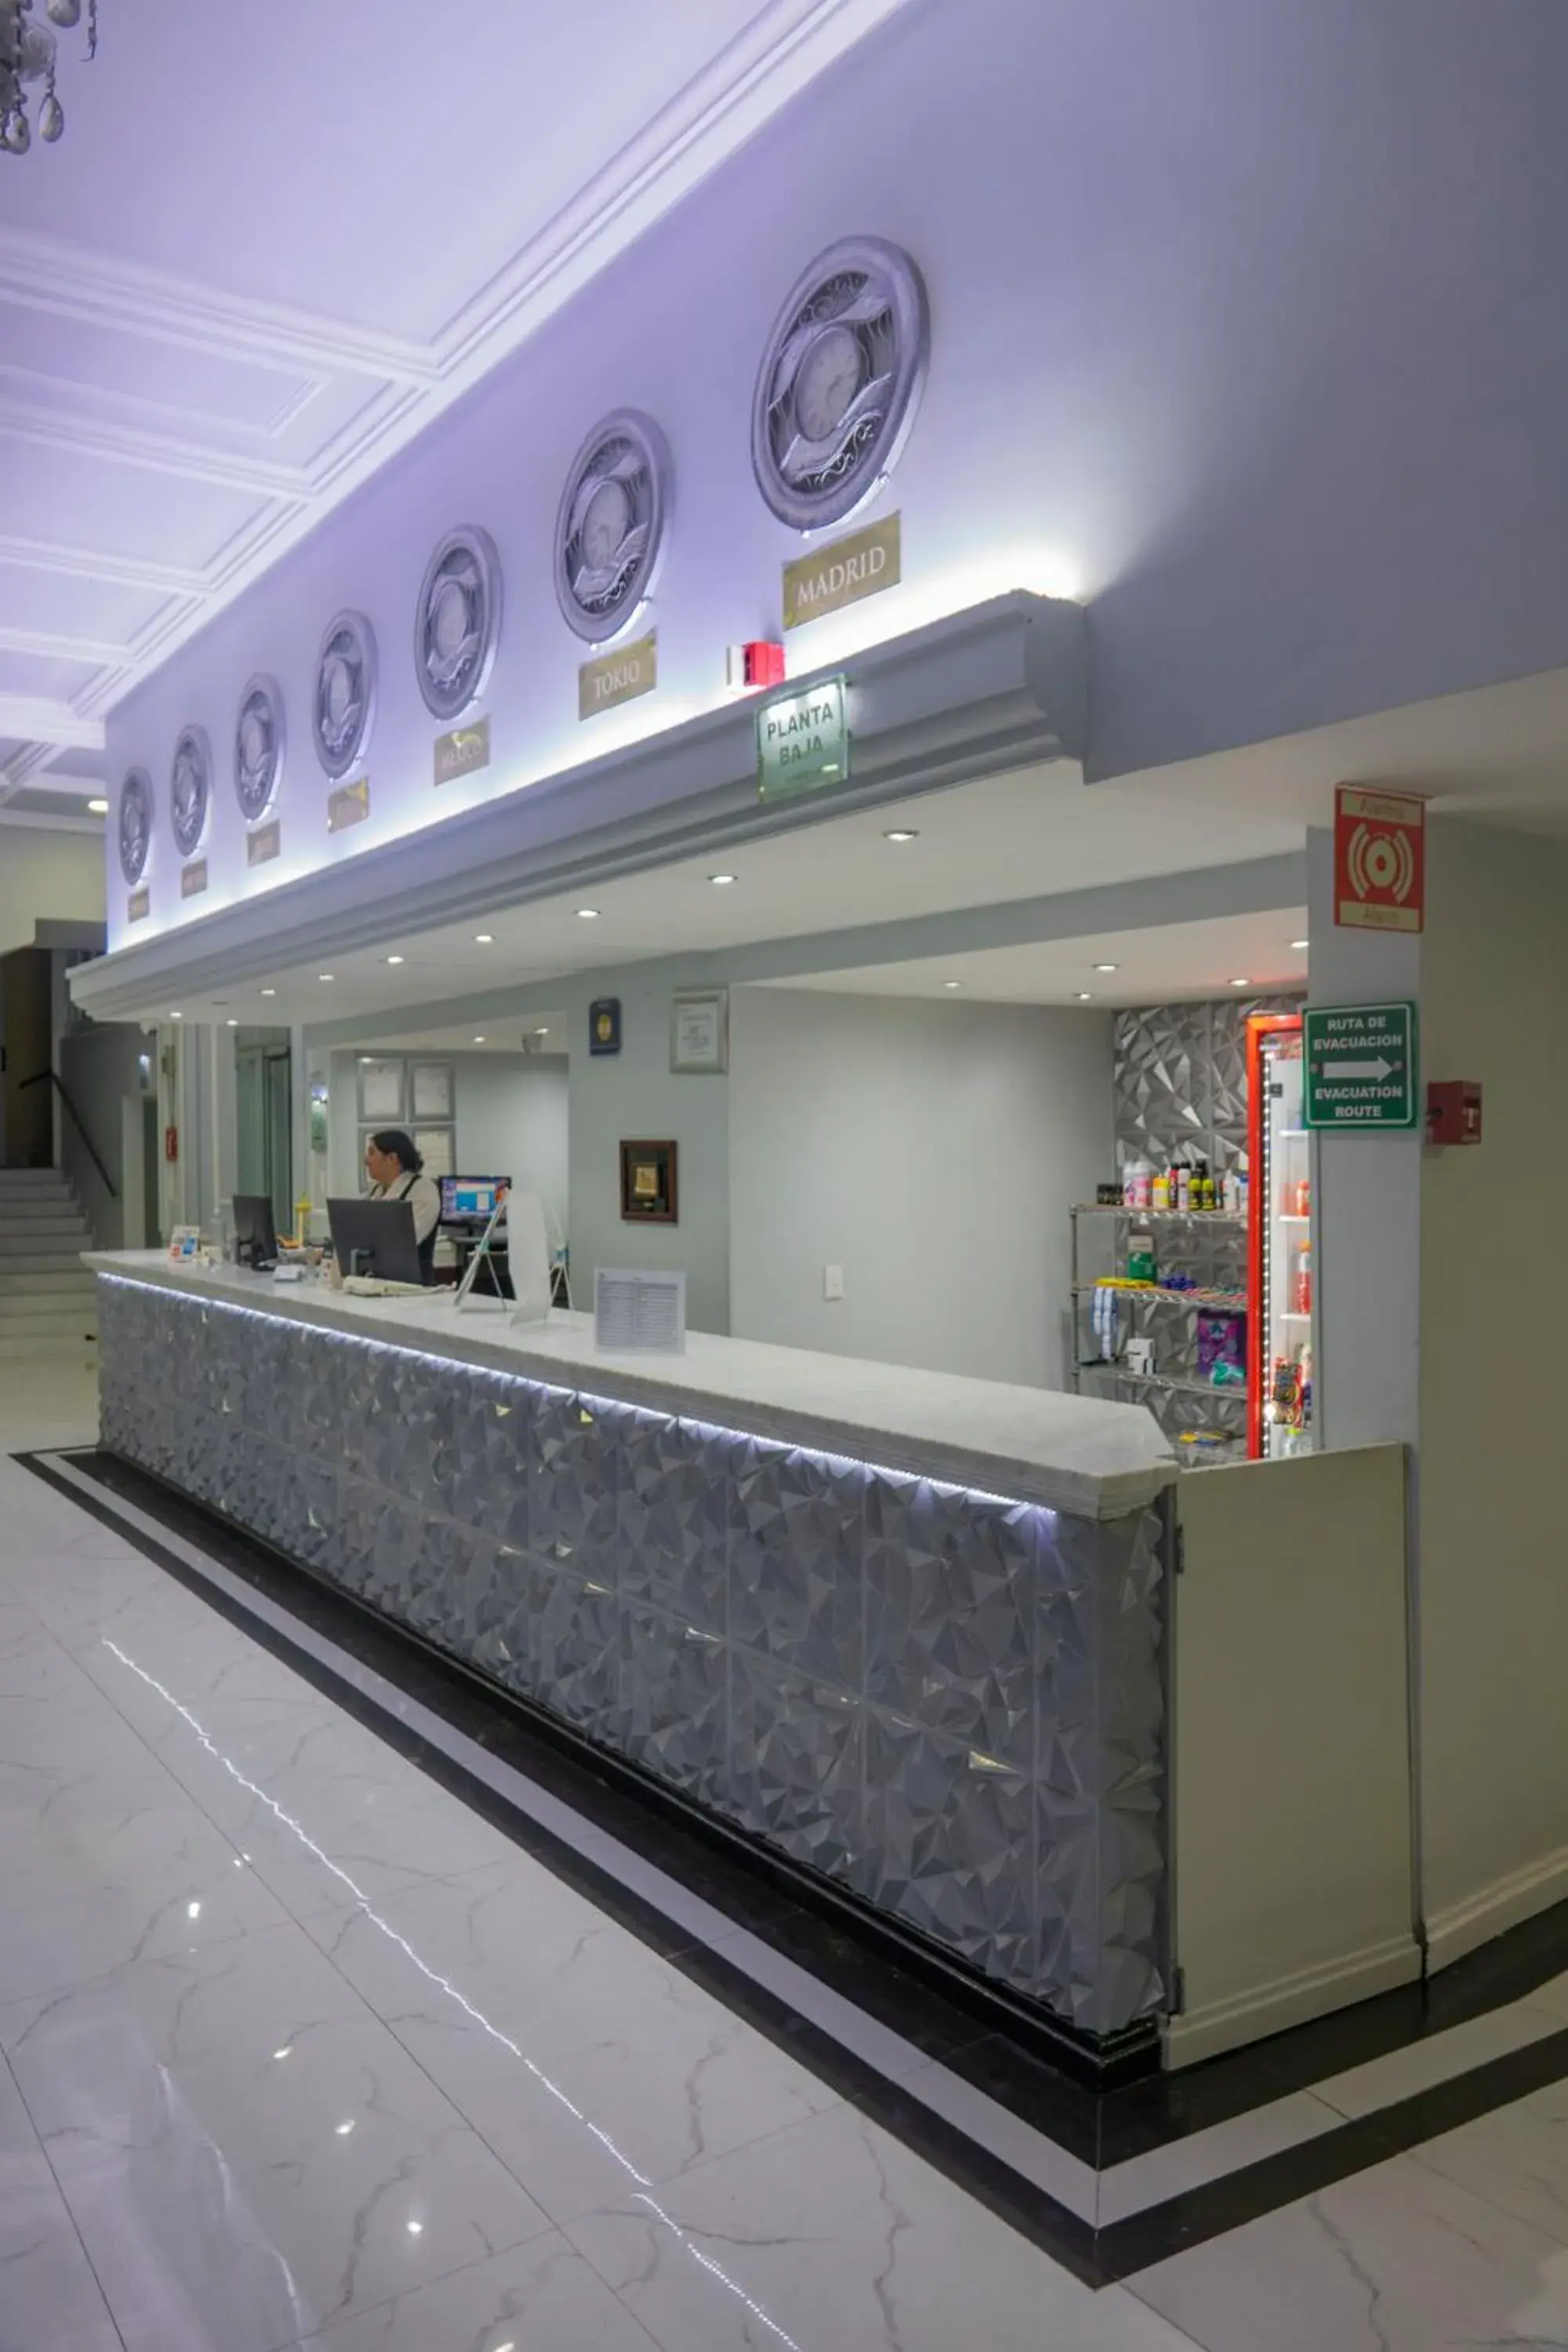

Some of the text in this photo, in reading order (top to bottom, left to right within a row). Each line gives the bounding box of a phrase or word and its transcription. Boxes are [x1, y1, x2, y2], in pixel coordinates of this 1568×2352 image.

[797, 546, 887, 608] MADRID
[593, 659, 641, 699] TOKIO
[766, 702, 834, 741] PLANTA
[779, 734, 824, 768] BAJA
[1327, 1016, 1386, 1031] RUTA DE
[1315, 1085, 1403, 1100] EVACUATION
[1334, 1105, 1382, 1117] ROUTE
